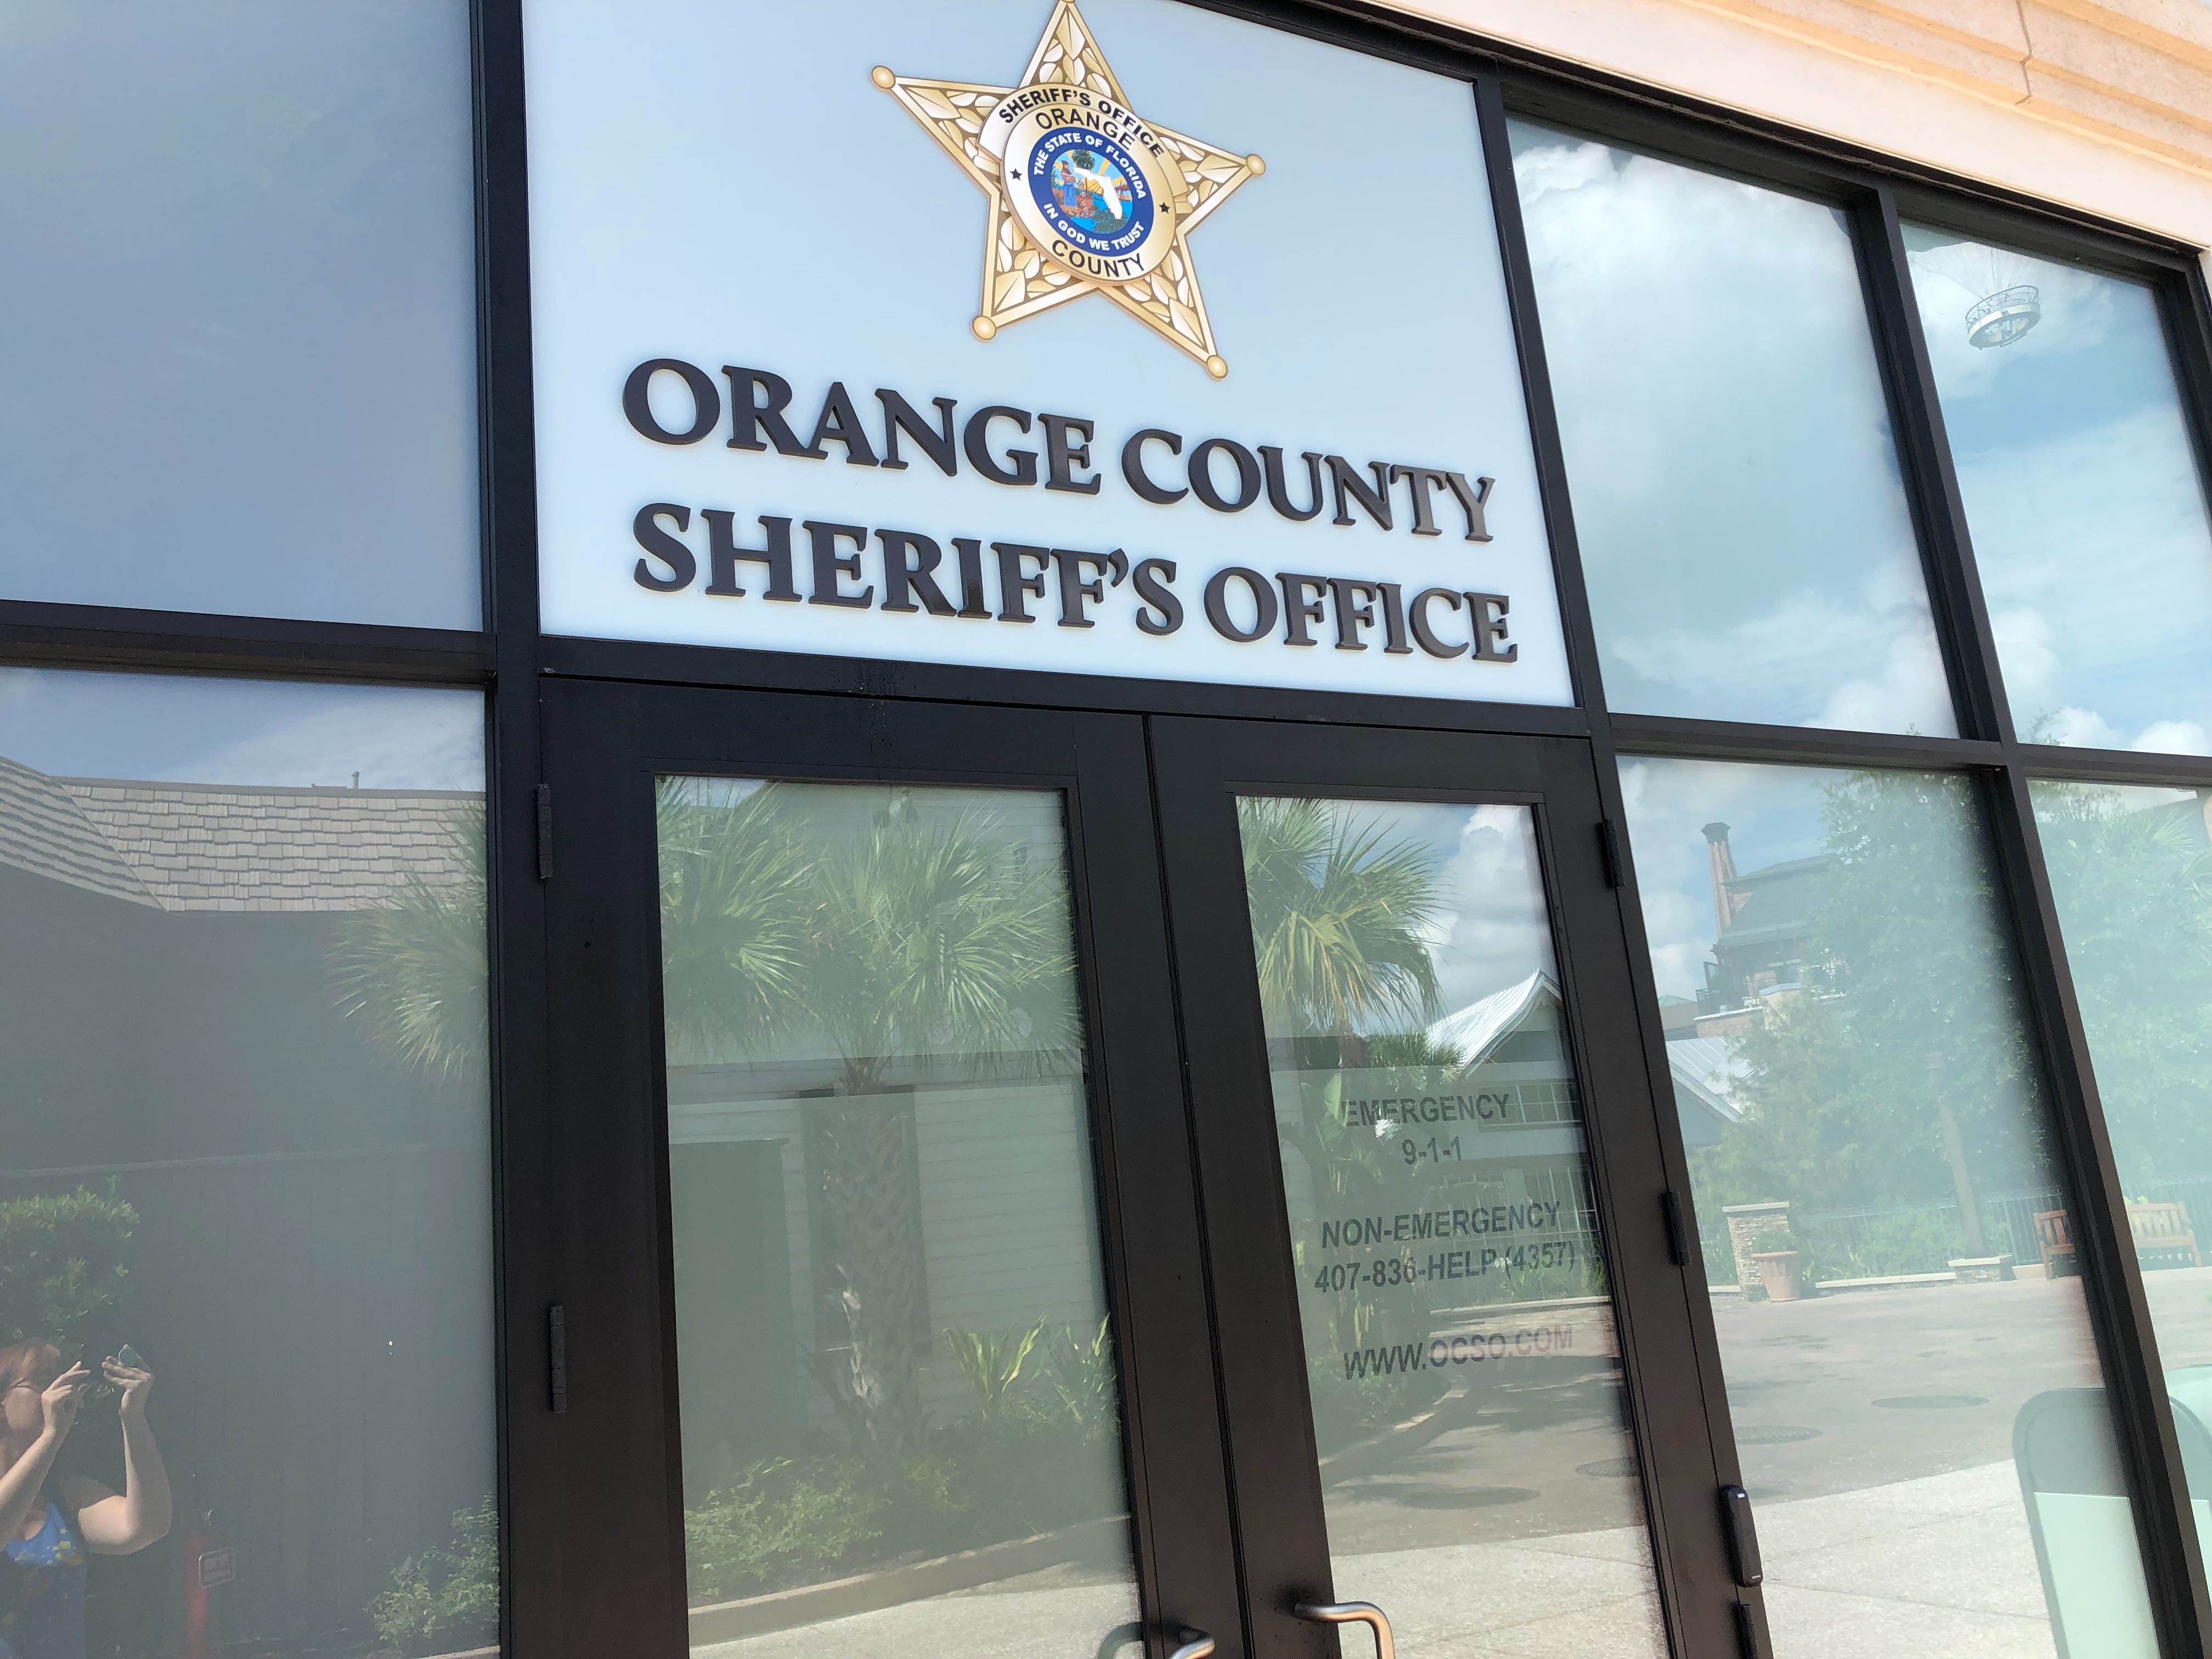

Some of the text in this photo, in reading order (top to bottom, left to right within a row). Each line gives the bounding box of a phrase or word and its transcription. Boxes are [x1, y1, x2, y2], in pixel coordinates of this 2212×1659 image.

[999, 88, 1164, 157] SHERIFF'S OFFICE
[1035, 108, 1135, 151] ORANGE
[1034, 133, 1147, 199] THE STATE OF FLORIDA
[1043, 203, 1144, 251] IN GOD WE TRUST
[1052, 239, 1144, 278] COUNTY
[623, 358, 1496, 543] ORANGE COUNTY
[633, 502, 1518, 663] SHERIFF'S OFFICE
[1341, 1093, 1510, 1127] EMERGENCY
[1402, 1137, 1462, 1165] 9-1-1
[1322, 1201, 1560, 1248] NON-EMERGENCY
[1314, 1240, 1575, 1293] 407-836-HELP (4357)
[1343, 1324, 1573, 1380] WWW.OCSO.COM
